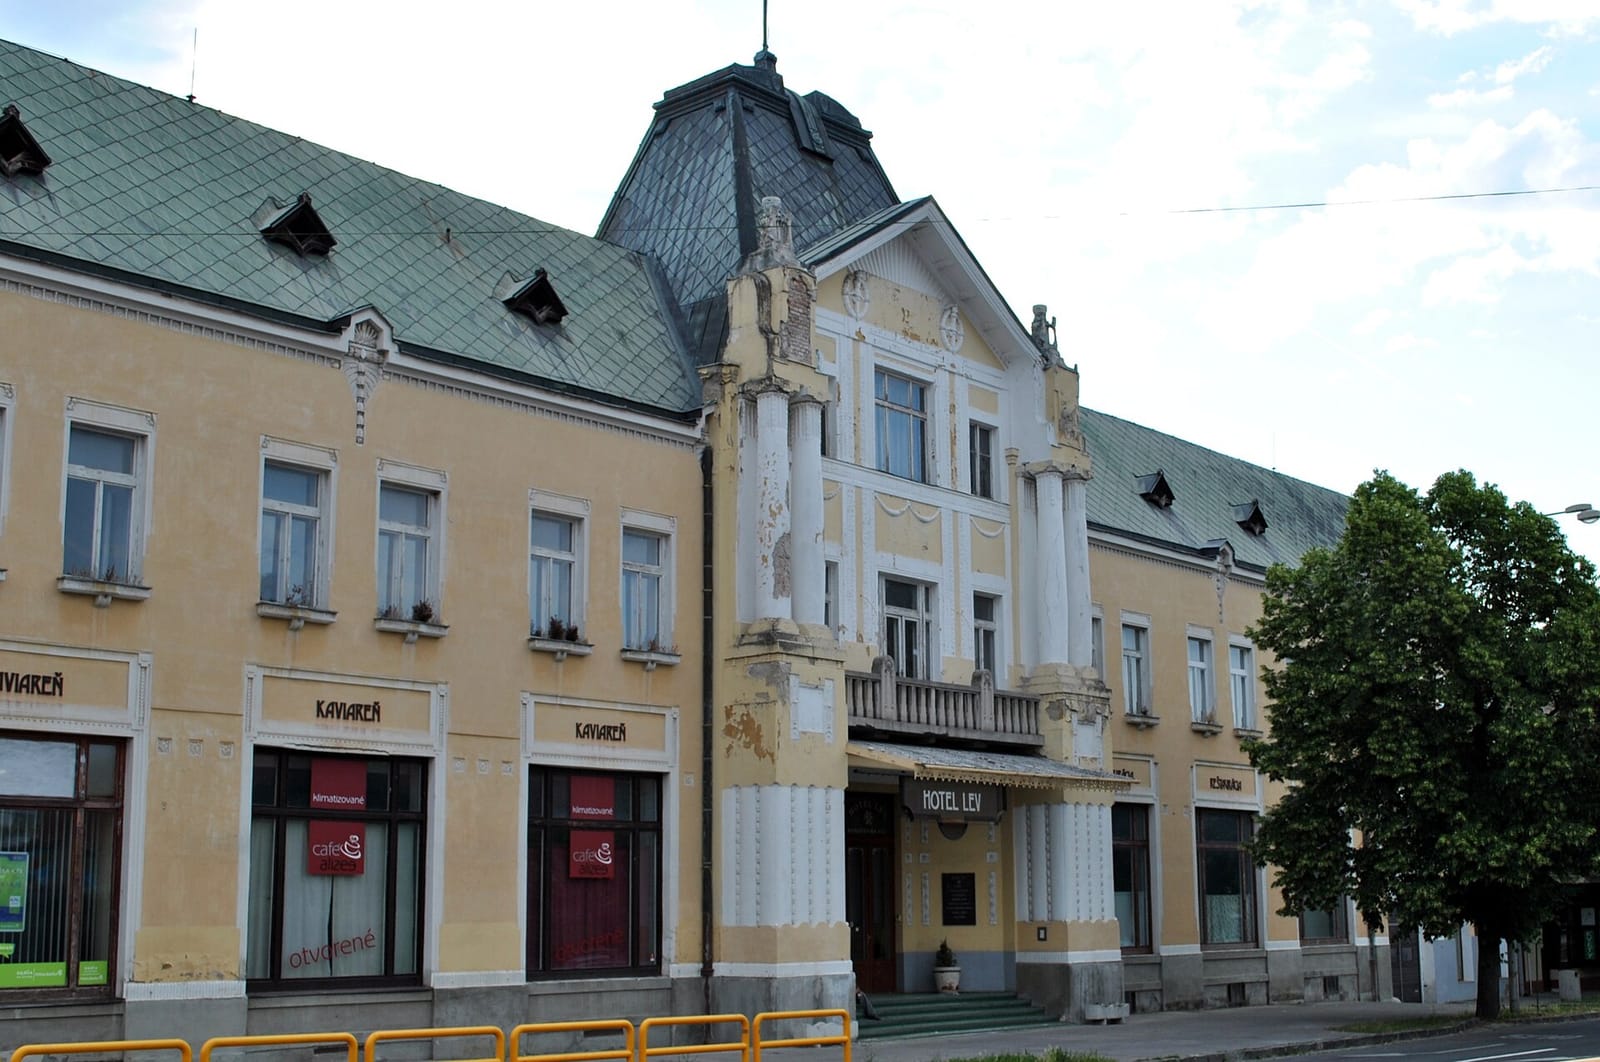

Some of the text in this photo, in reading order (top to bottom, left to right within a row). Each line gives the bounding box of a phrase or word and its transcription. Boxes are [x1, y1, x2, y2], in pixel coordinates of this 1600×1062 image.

[316, 699, 381, 723] KAVIAREŇ
[575, 722, 626, 743] KAVIAREŇ
[312, 792, 366, 805] klimatizované
[923, 789, 981, 812] HOTEL LEV
[289, 927, 377, 969] otvorené
